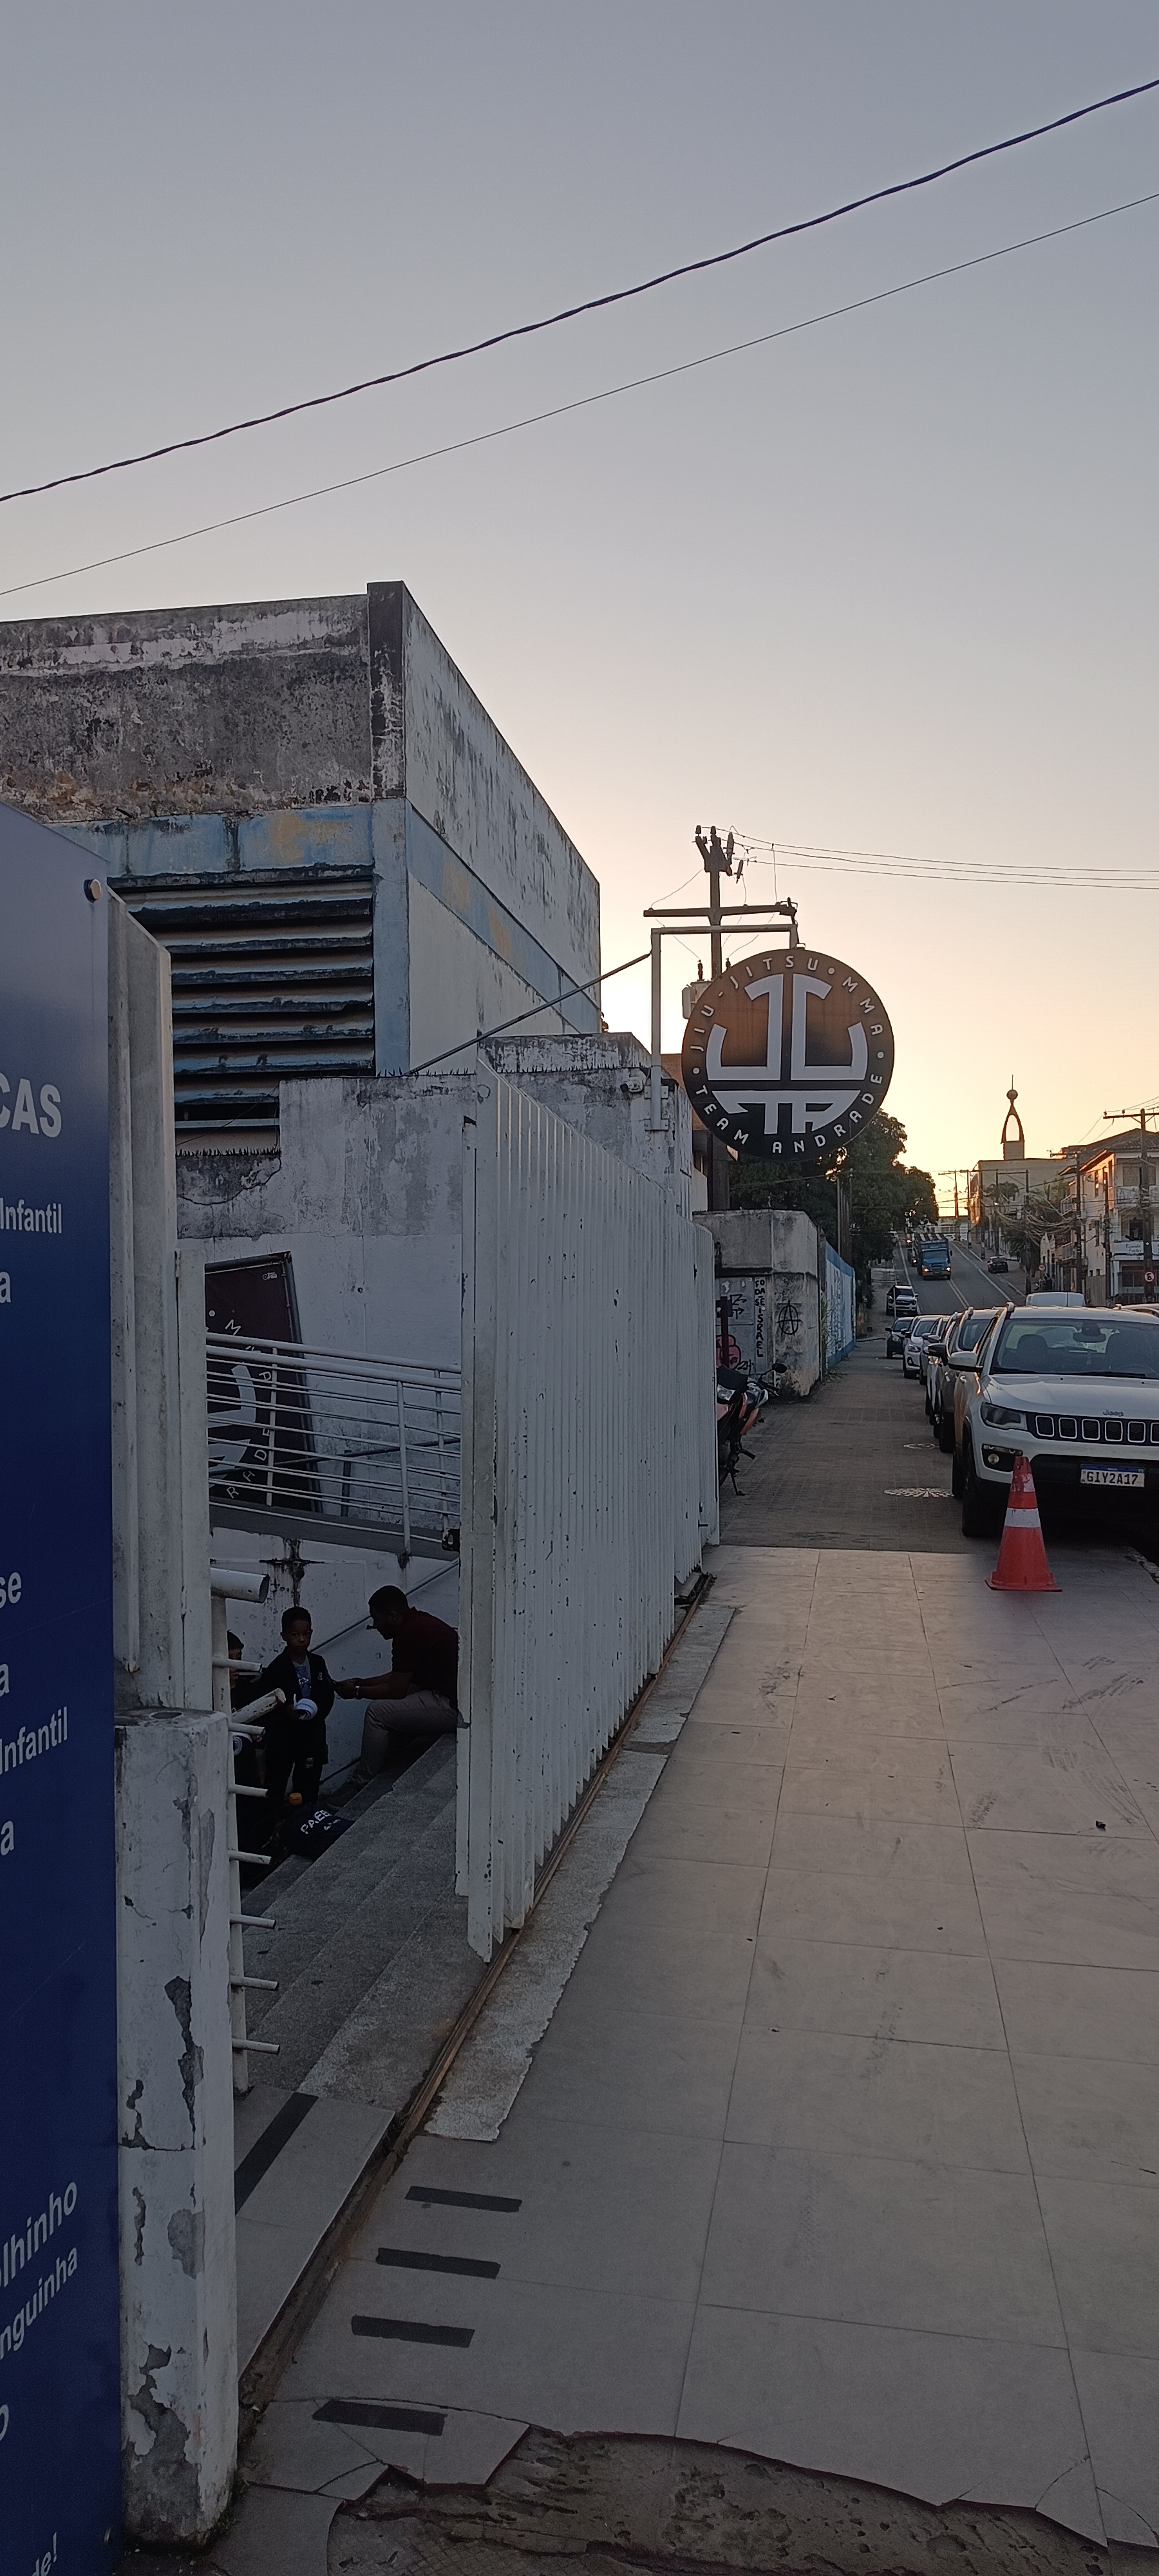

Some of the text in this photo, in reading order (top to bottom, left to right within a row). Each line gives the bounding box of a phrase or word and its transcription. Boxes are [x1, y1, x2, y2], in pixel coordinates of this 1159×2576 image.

[690, 955, 883, 1052] JIU-JITSU MMA
[695, 1074, 883, 1154] TEAM ANDRADE
[0, 1197, 62, 1233] Infantil
[1087, 1471, 1138, 1485] GIY2A17
[0, 1706, 67, 1774] Infantil
[0, 1820, 14, 1855] a
[0, 2182, 77, 2288] lhinho
